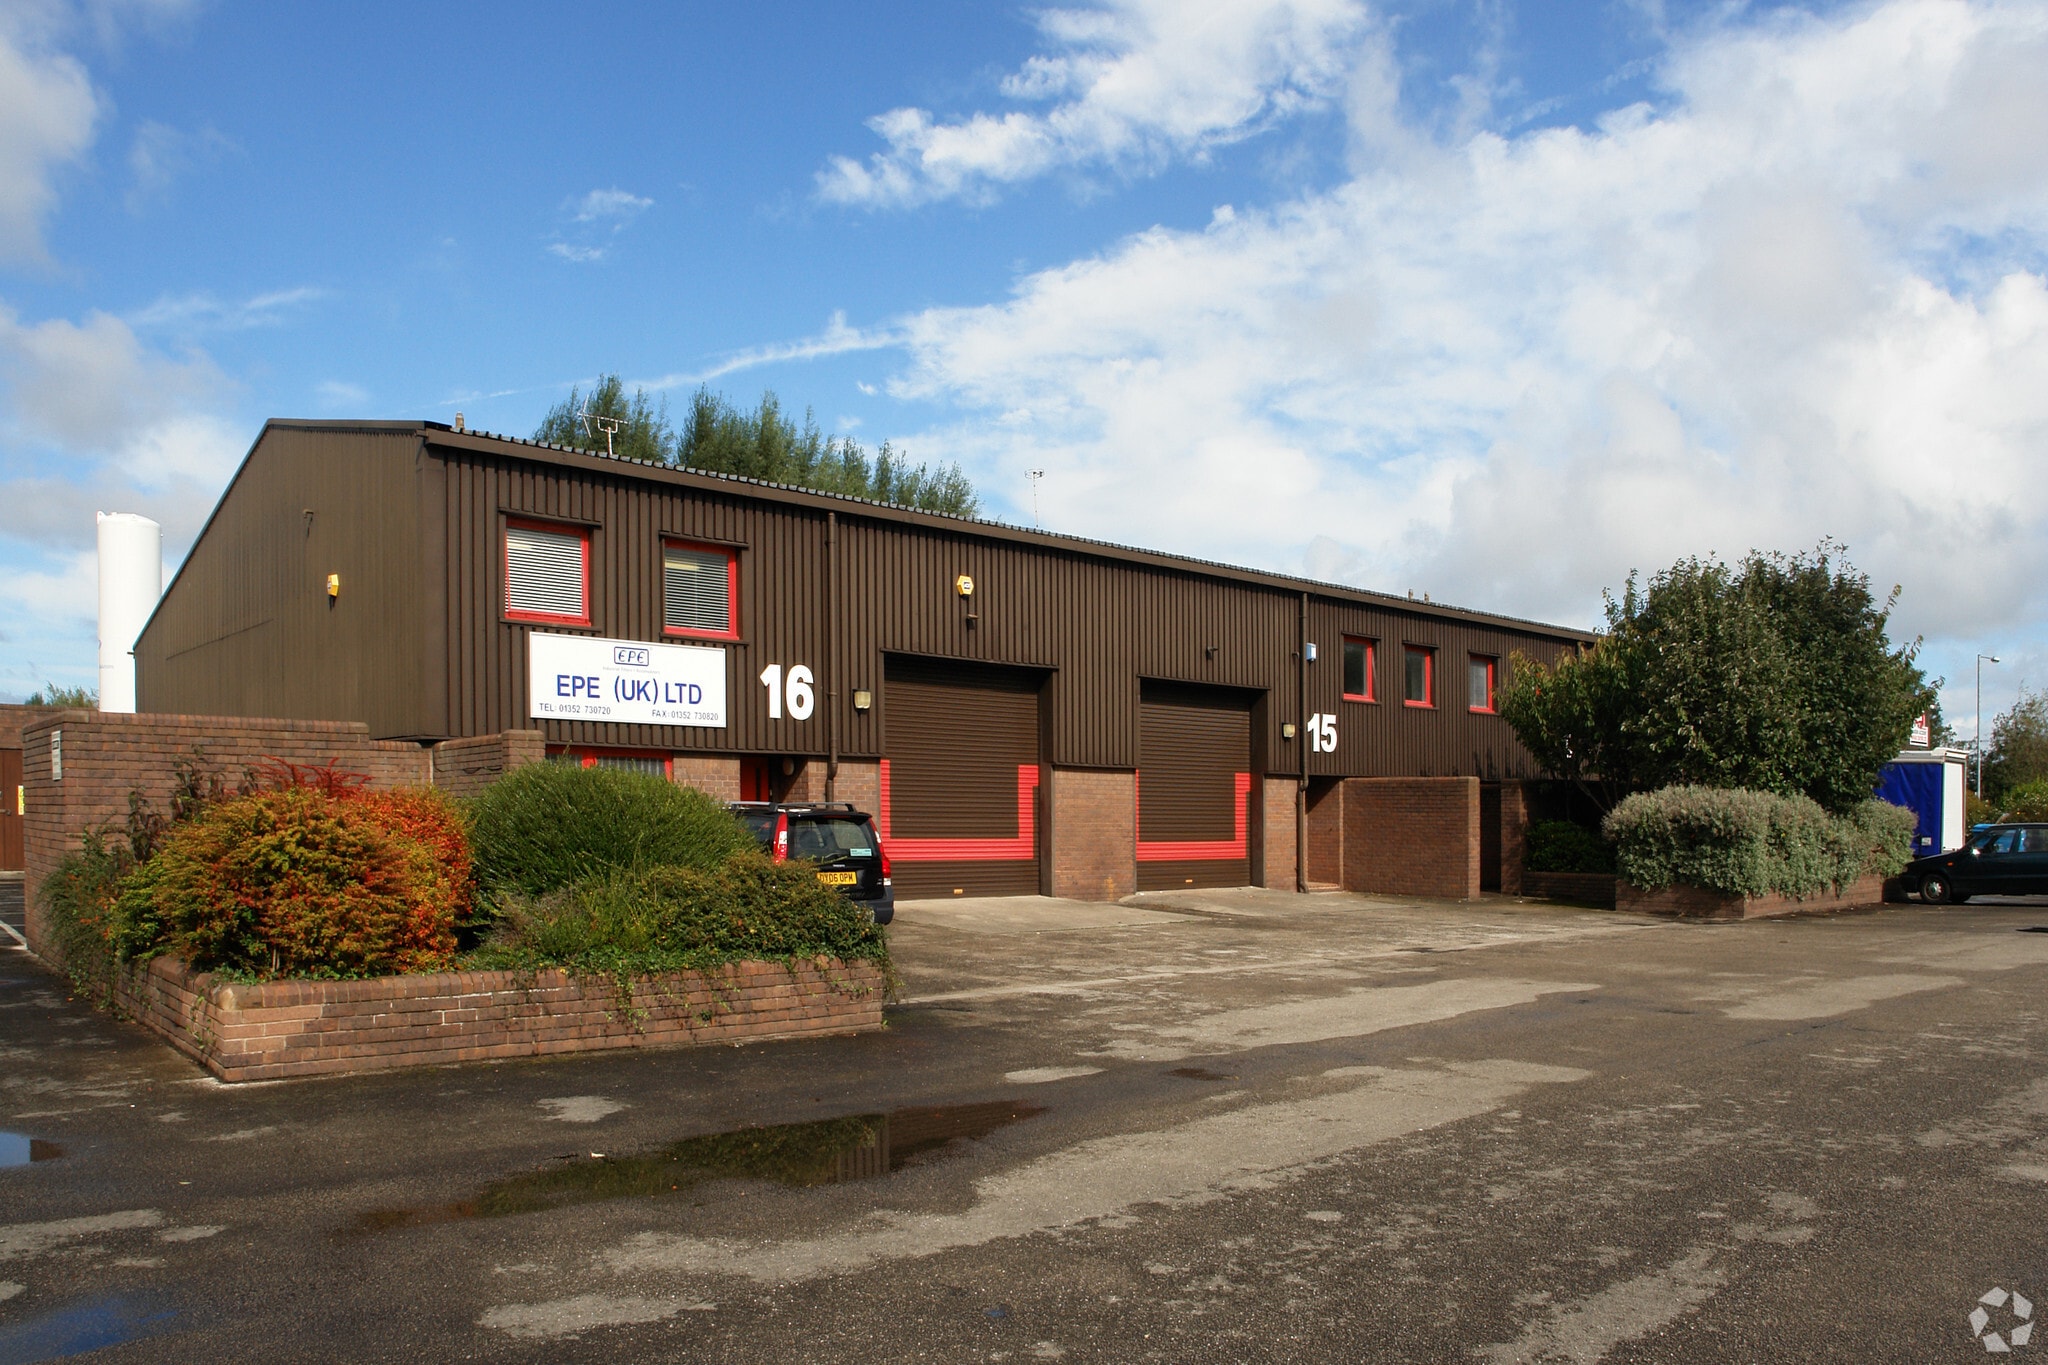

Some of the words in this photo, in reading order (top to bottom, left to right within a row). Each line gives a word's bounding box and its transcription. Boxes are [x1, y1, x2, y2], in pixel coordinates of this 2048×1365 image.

[618, 649, 646, 664] EPE
[557, 674, 600, 699] EPE
[614, 675, 658, 705] (UK)
[665, 682, 702, 705] LTD
[759, 664, 815, 721] 16
[559, 704, 580, 714] 01352
[584, 705, 611, 715] 730720
[671, 710, 691, 720] 01352
[694, 711, 719, 721] 730820
[1307, 713, 1338, 753] 15
